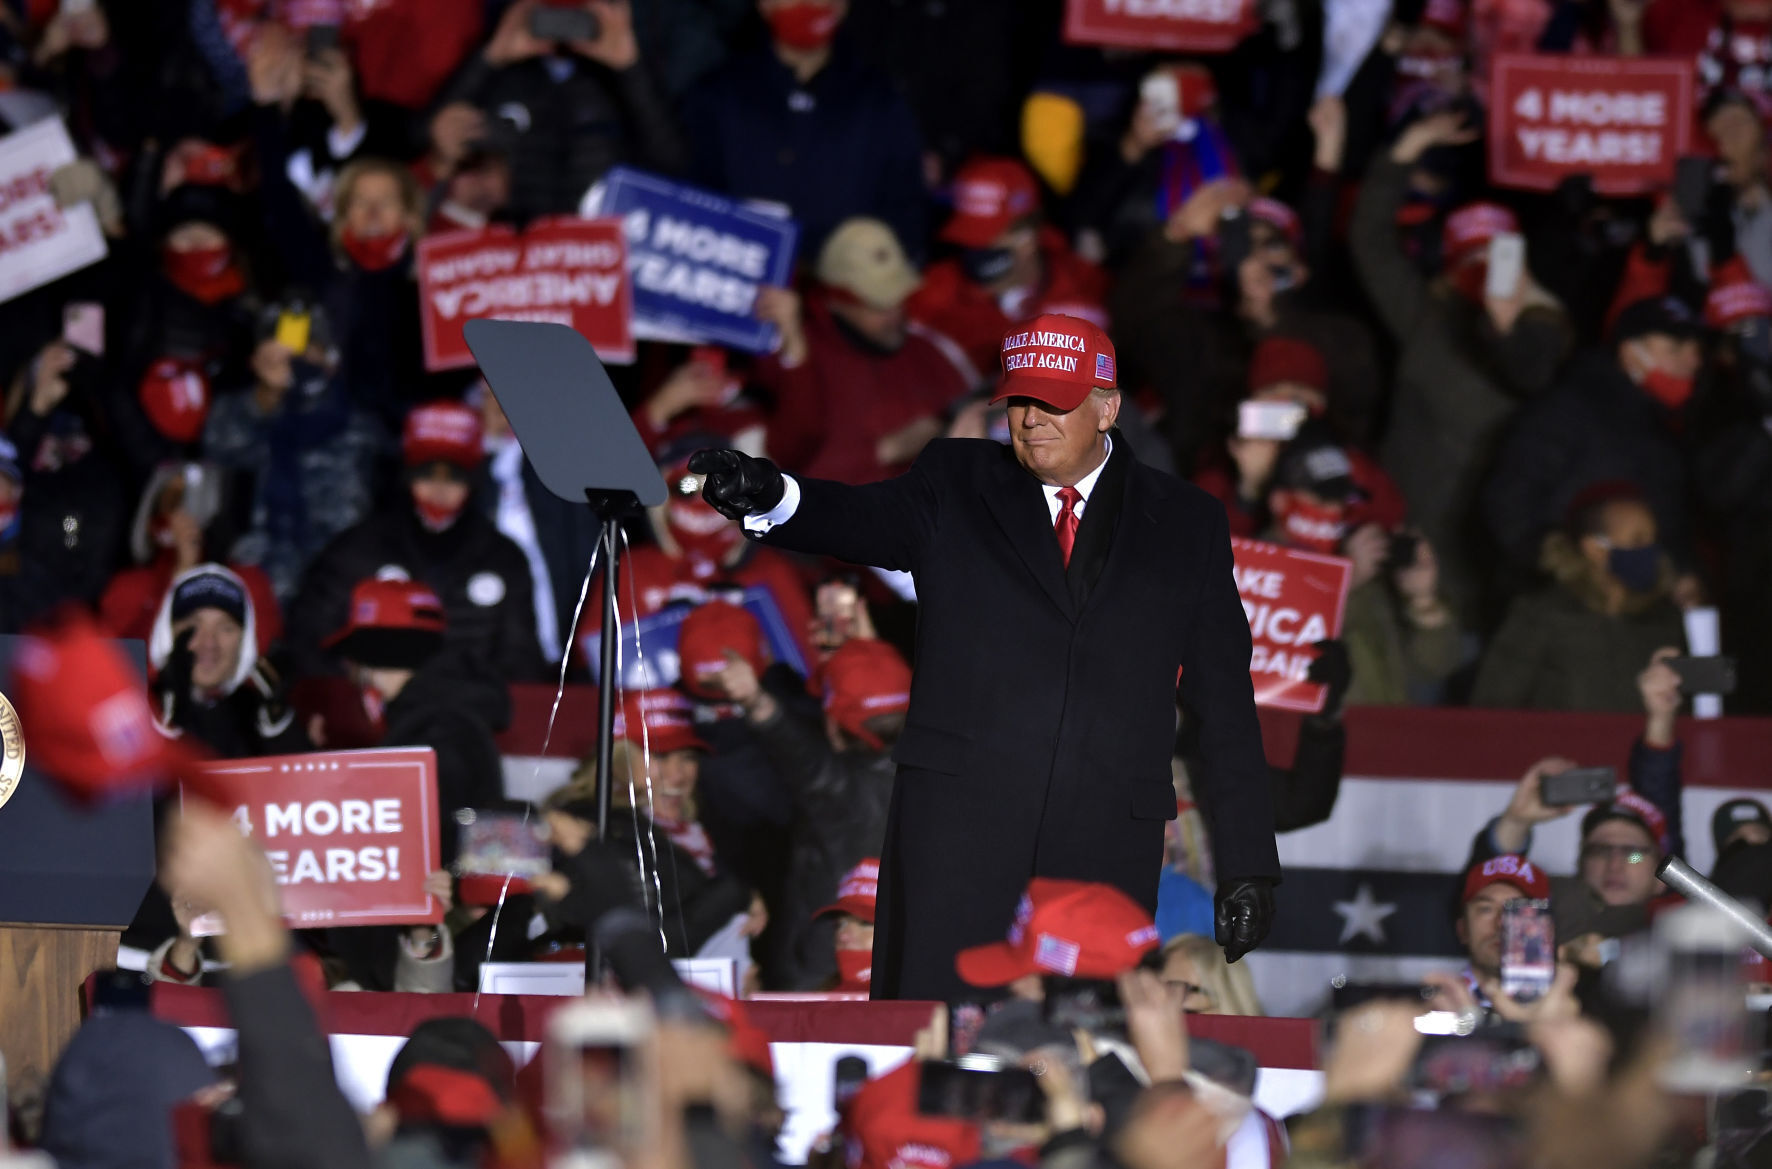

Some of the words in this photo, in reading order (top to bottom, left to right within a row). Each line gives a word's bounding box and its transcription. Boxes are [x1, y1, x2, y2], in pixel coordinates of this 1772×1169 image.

[1515, 86, 1541, 121] 4
[1550, 88, 1668, 126] MORE
[1517, 125, 1662, 165] YEARS!
[526, 241, 620, 271] GREAT
[653, 214, 769, 280] MORE
[429, 249, 518, 284] AGAIN
[434, 272, 620, 320] AMERICA
[1003, 332, 1028, 352] MAKE
[1028, 331, 1085, 352] AMERICA
[1006, 353, 1036, 372] GREAT
[1037, 353, 1078, 372] AGAIN
[234, 804, 254, 838] 4
[264, 798, 403, 837] MORE
[264, 846, 400, 884] EARS!
[1482, 855, 1536, 884] USA
